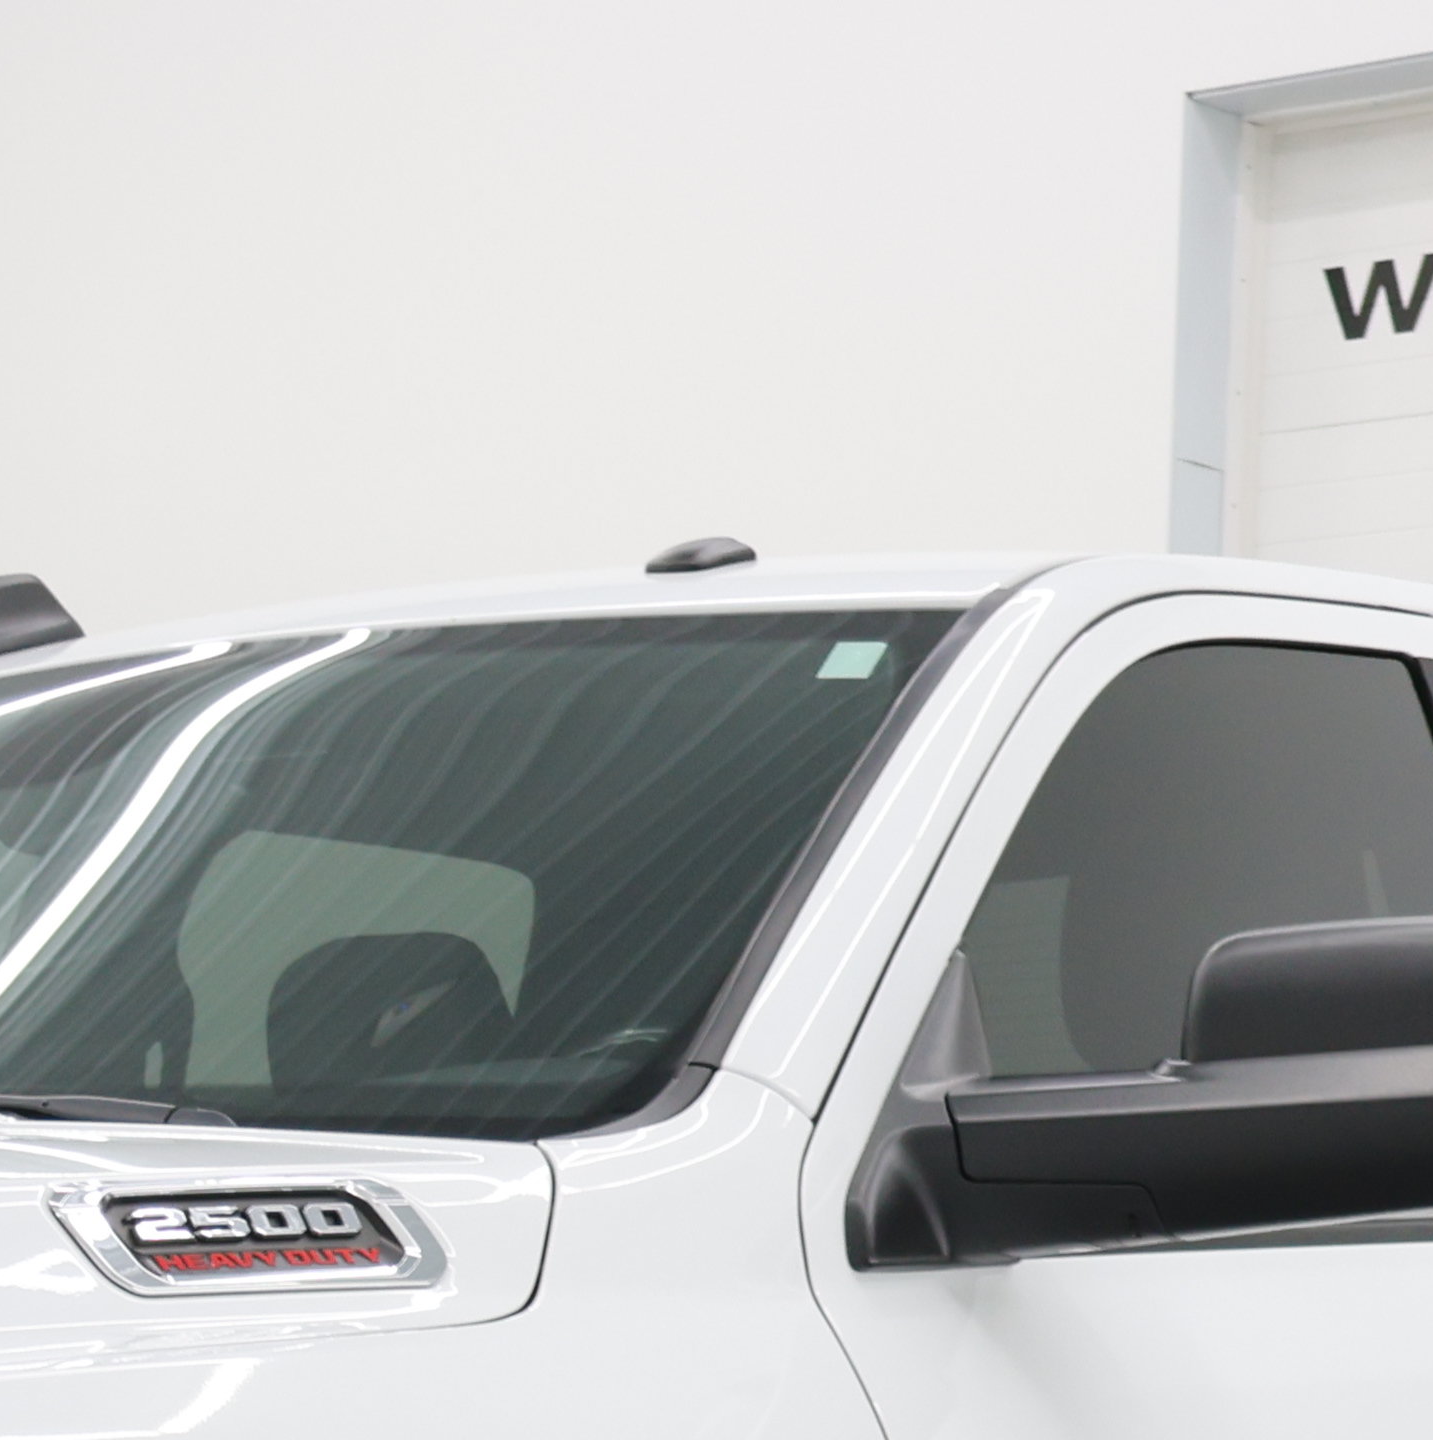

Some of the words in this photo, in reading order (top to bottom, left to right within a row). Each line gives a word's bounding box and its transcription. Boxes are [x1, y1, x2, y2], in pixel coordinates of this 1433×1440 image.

[131, 1202, 364, 1243] 2500
[155, 1249, 278, 1271] HEAVY
[283, 1246, 381, 1268] DUTY
